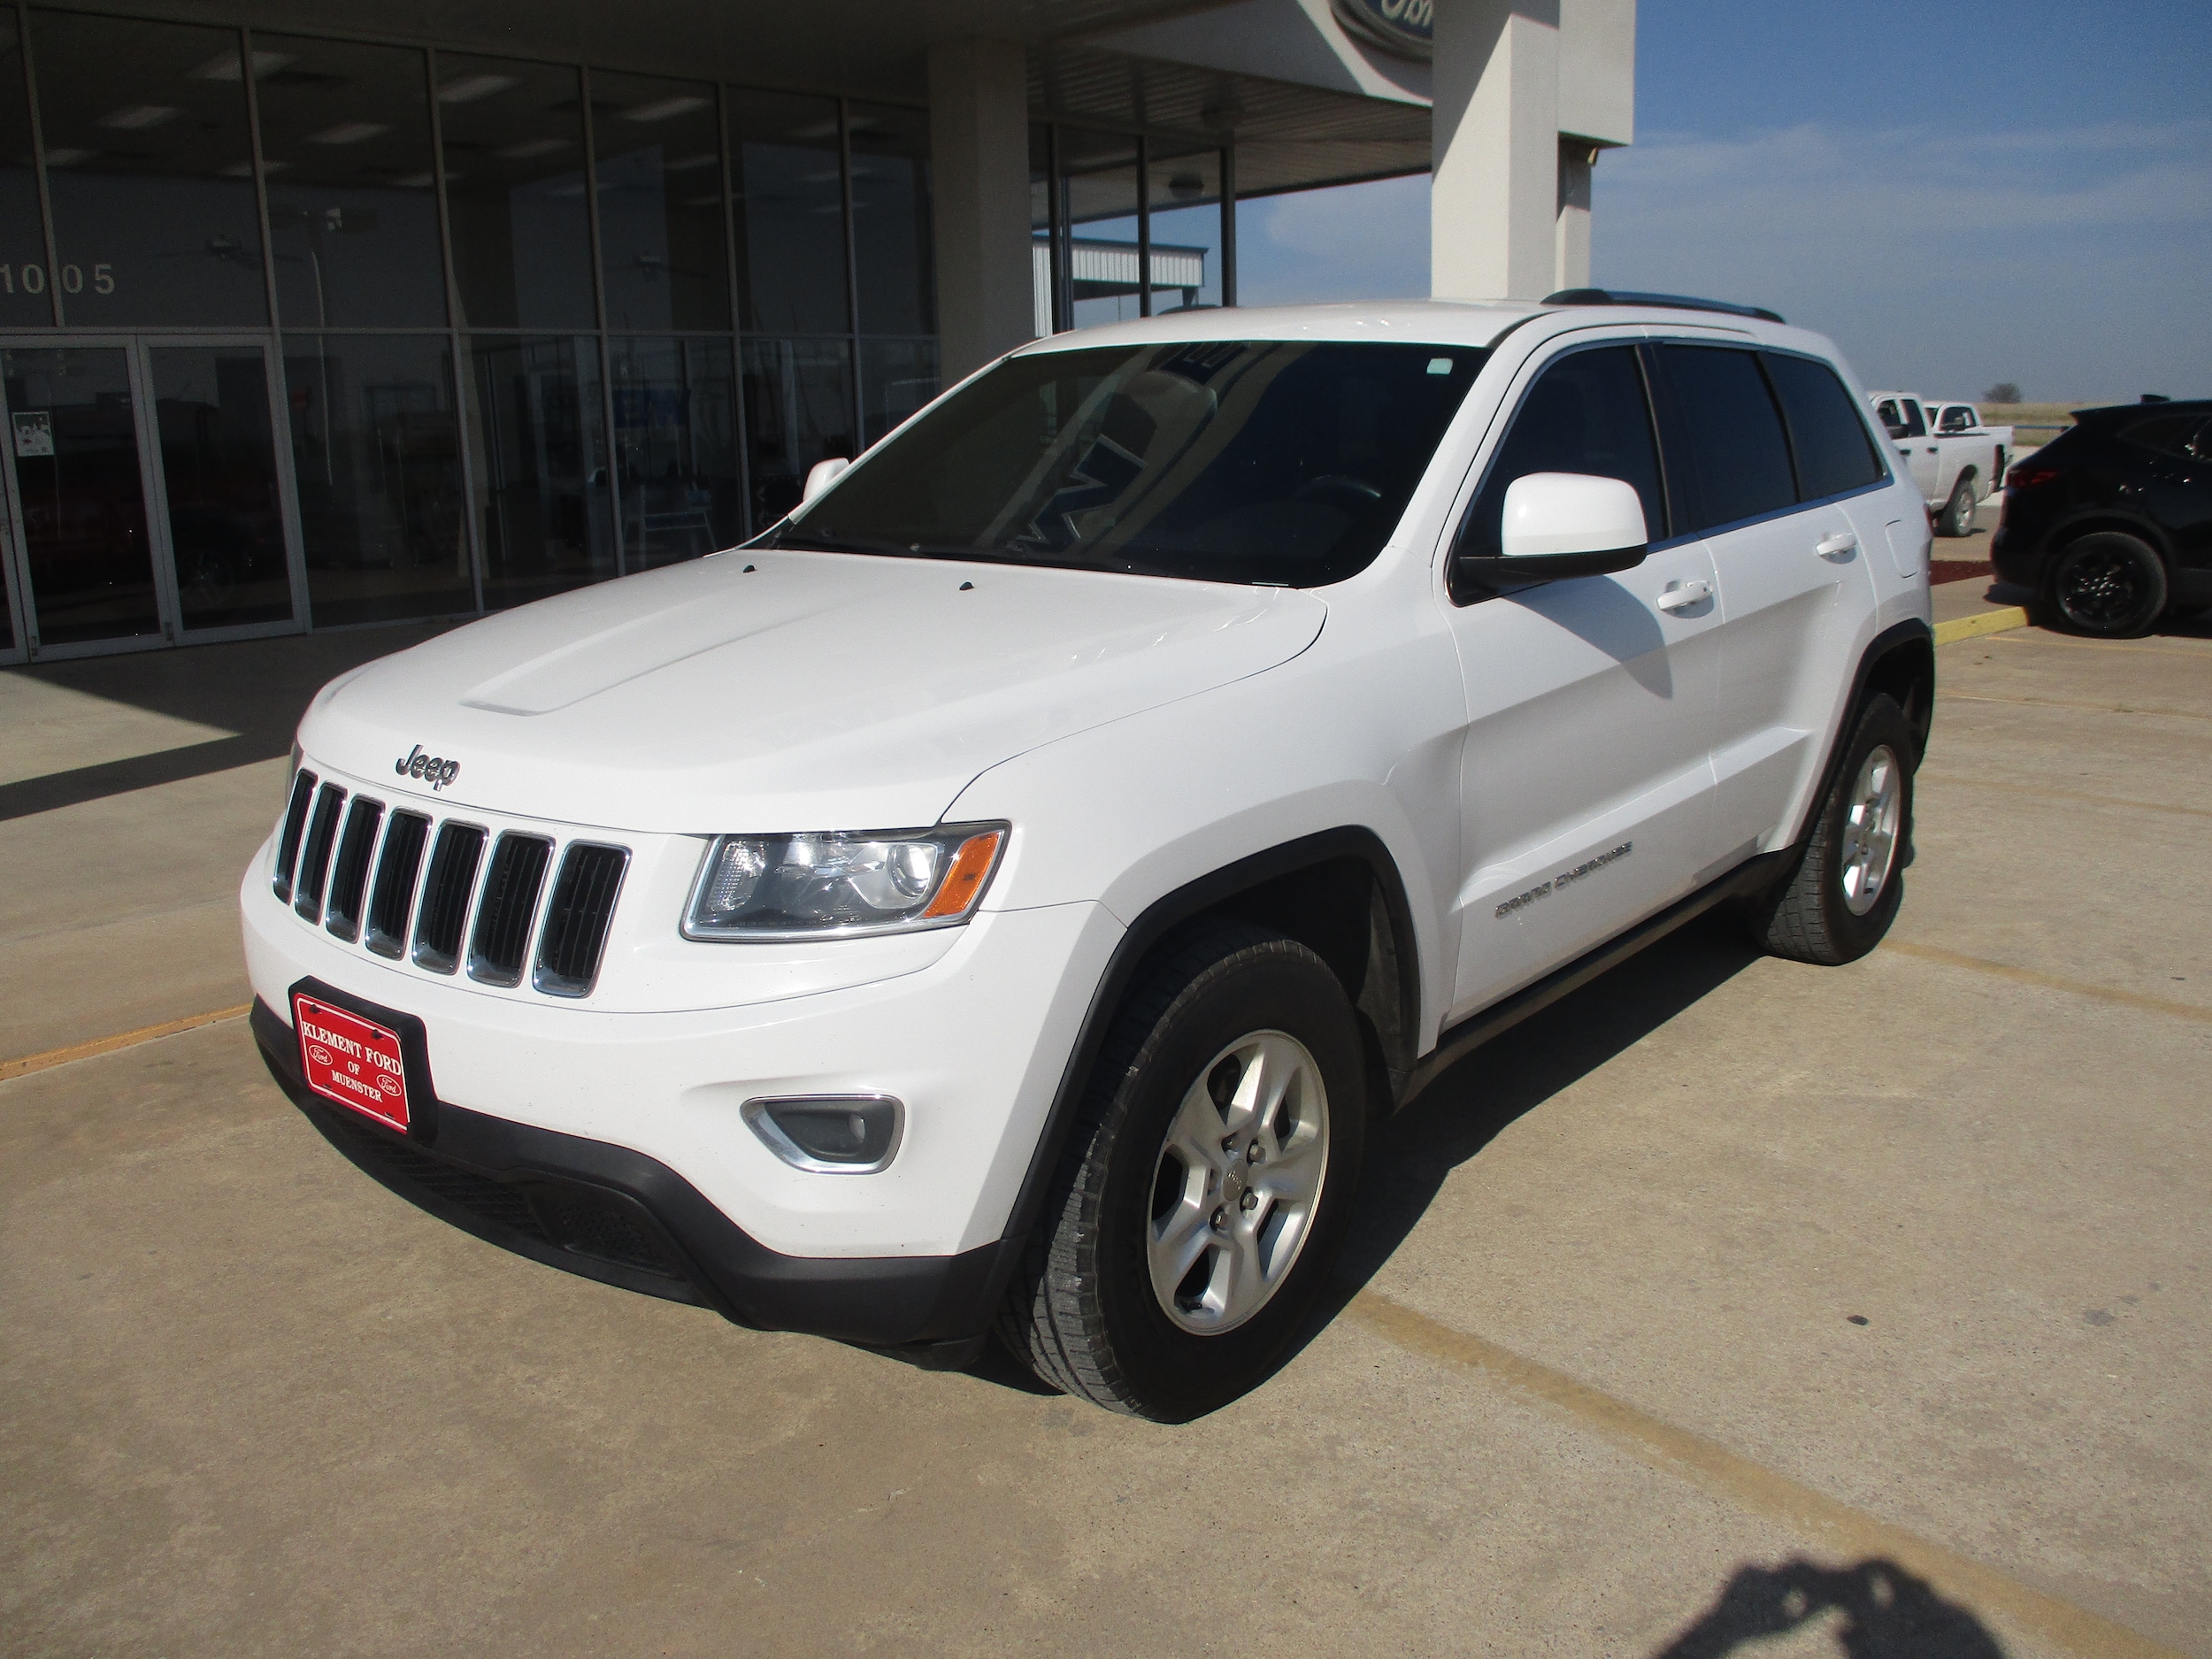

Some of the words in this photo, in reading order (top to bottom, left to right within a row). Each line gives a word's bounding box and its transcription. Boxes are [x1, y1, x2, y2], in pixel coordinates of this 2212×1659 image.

[396, 744, 461, 792] Jeep
[302, 1020, 362, 1058] KLEMENT
[365, 1046, 402, 1076] FORD
[311, 1047, 328, 1063] Ford
[348, 1060, 360, 1075] OF
[331, 1069, 383, 1103] MUENSTER
[380, 1077, 397, 1094] Ford
